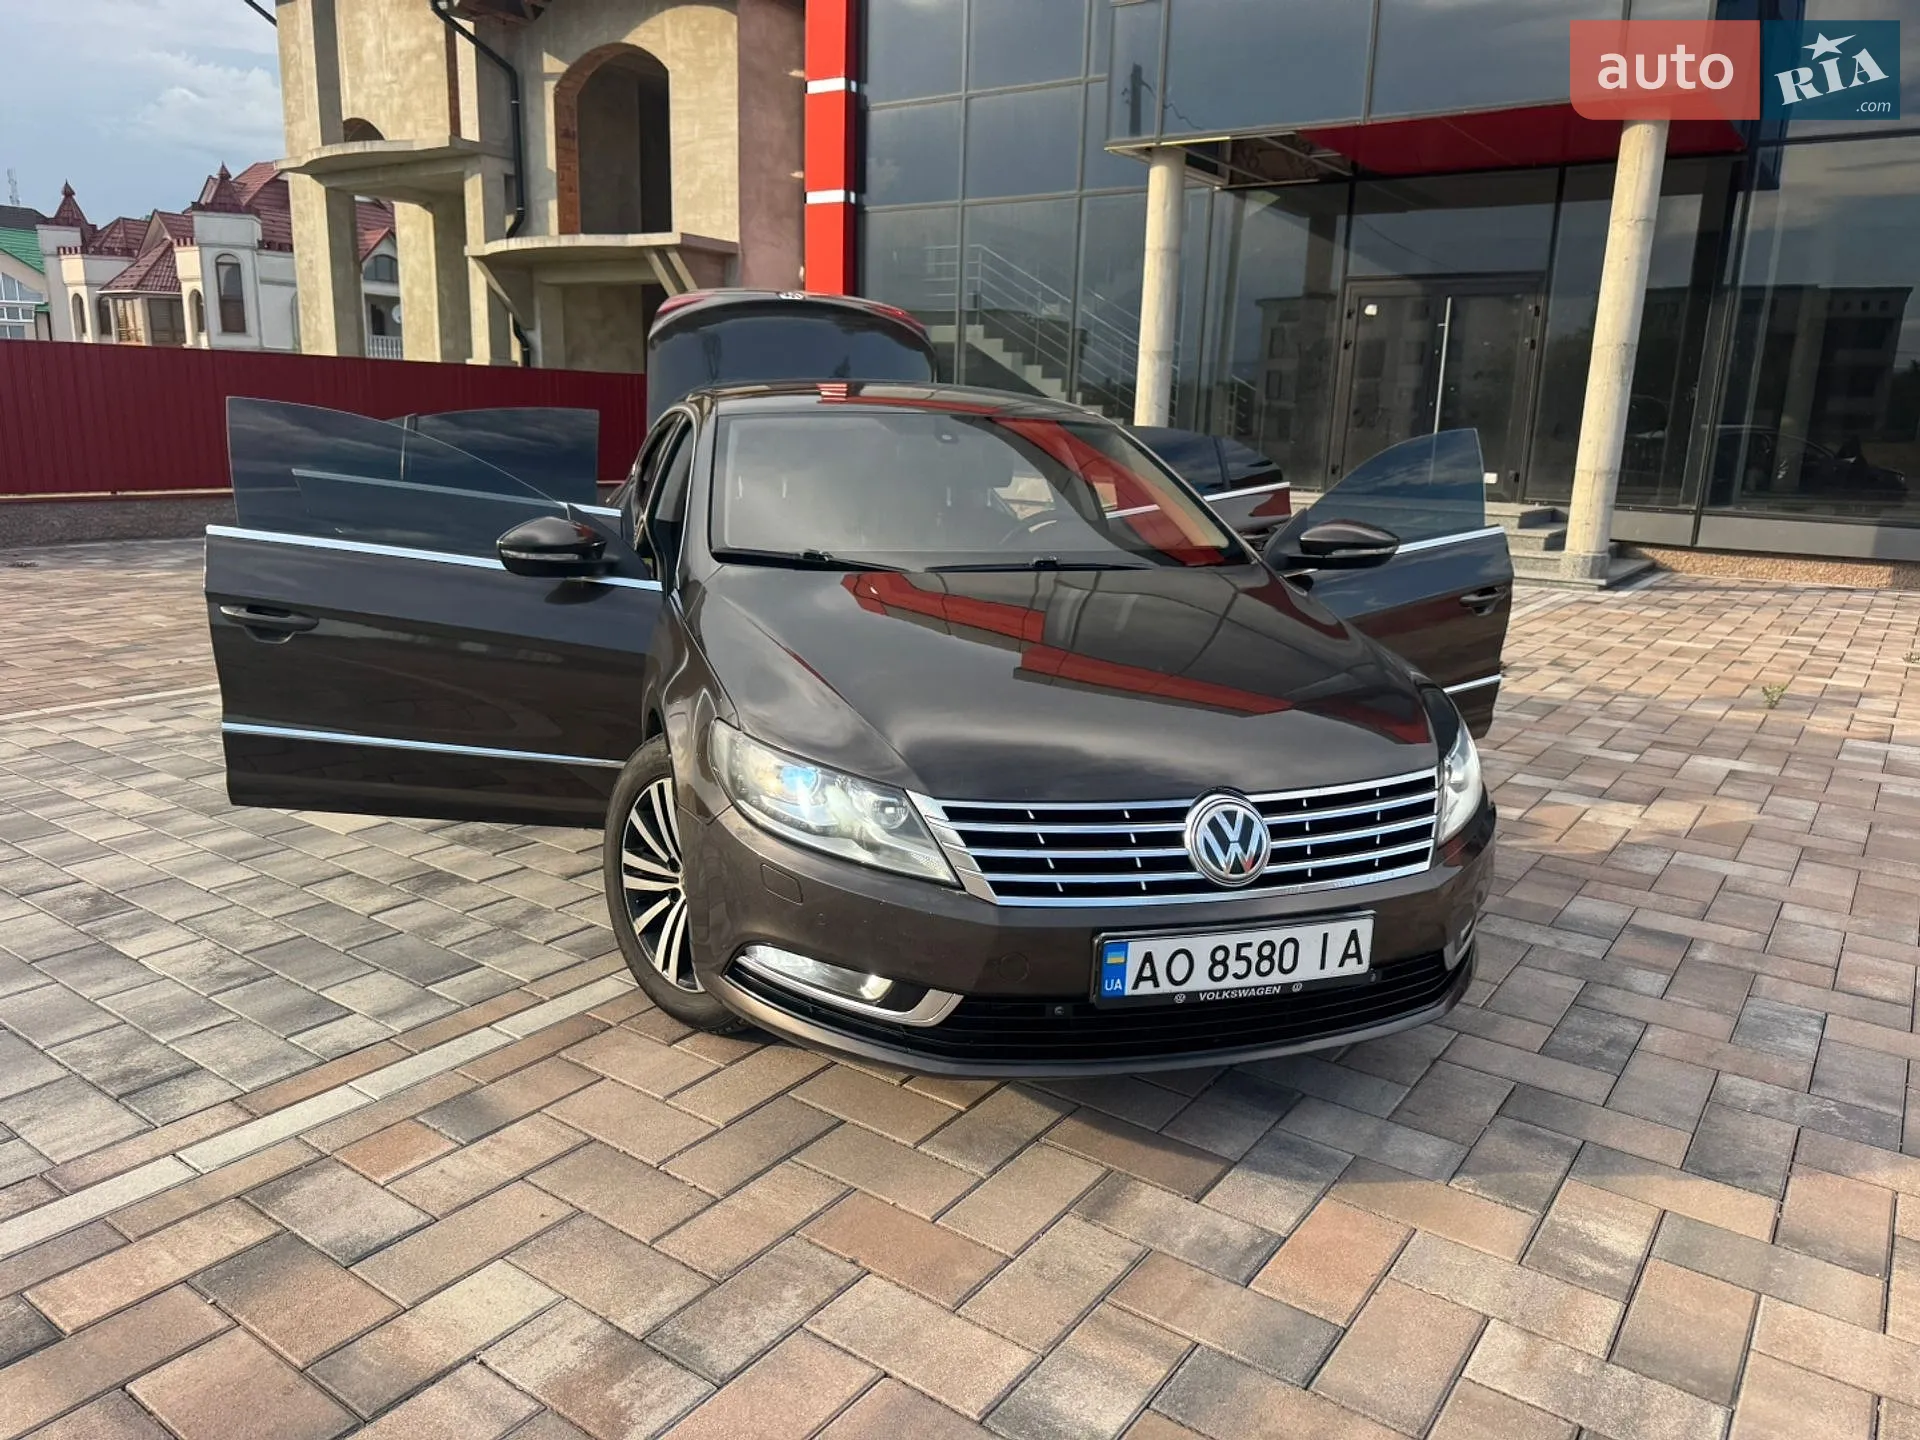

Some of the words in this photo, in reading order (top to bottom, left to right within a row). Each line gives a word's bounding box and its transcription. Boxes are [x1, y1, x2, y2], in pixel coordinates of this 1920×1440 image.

[1131, 948, 1195, 990] AO
[1207, 936, 1300, 983] 8580
[1319, 928, 1364, 970] IA
[1104, 977, 1123, 992] UA
[1199, 985, 1282, 1001] VOLKSWAGEN
